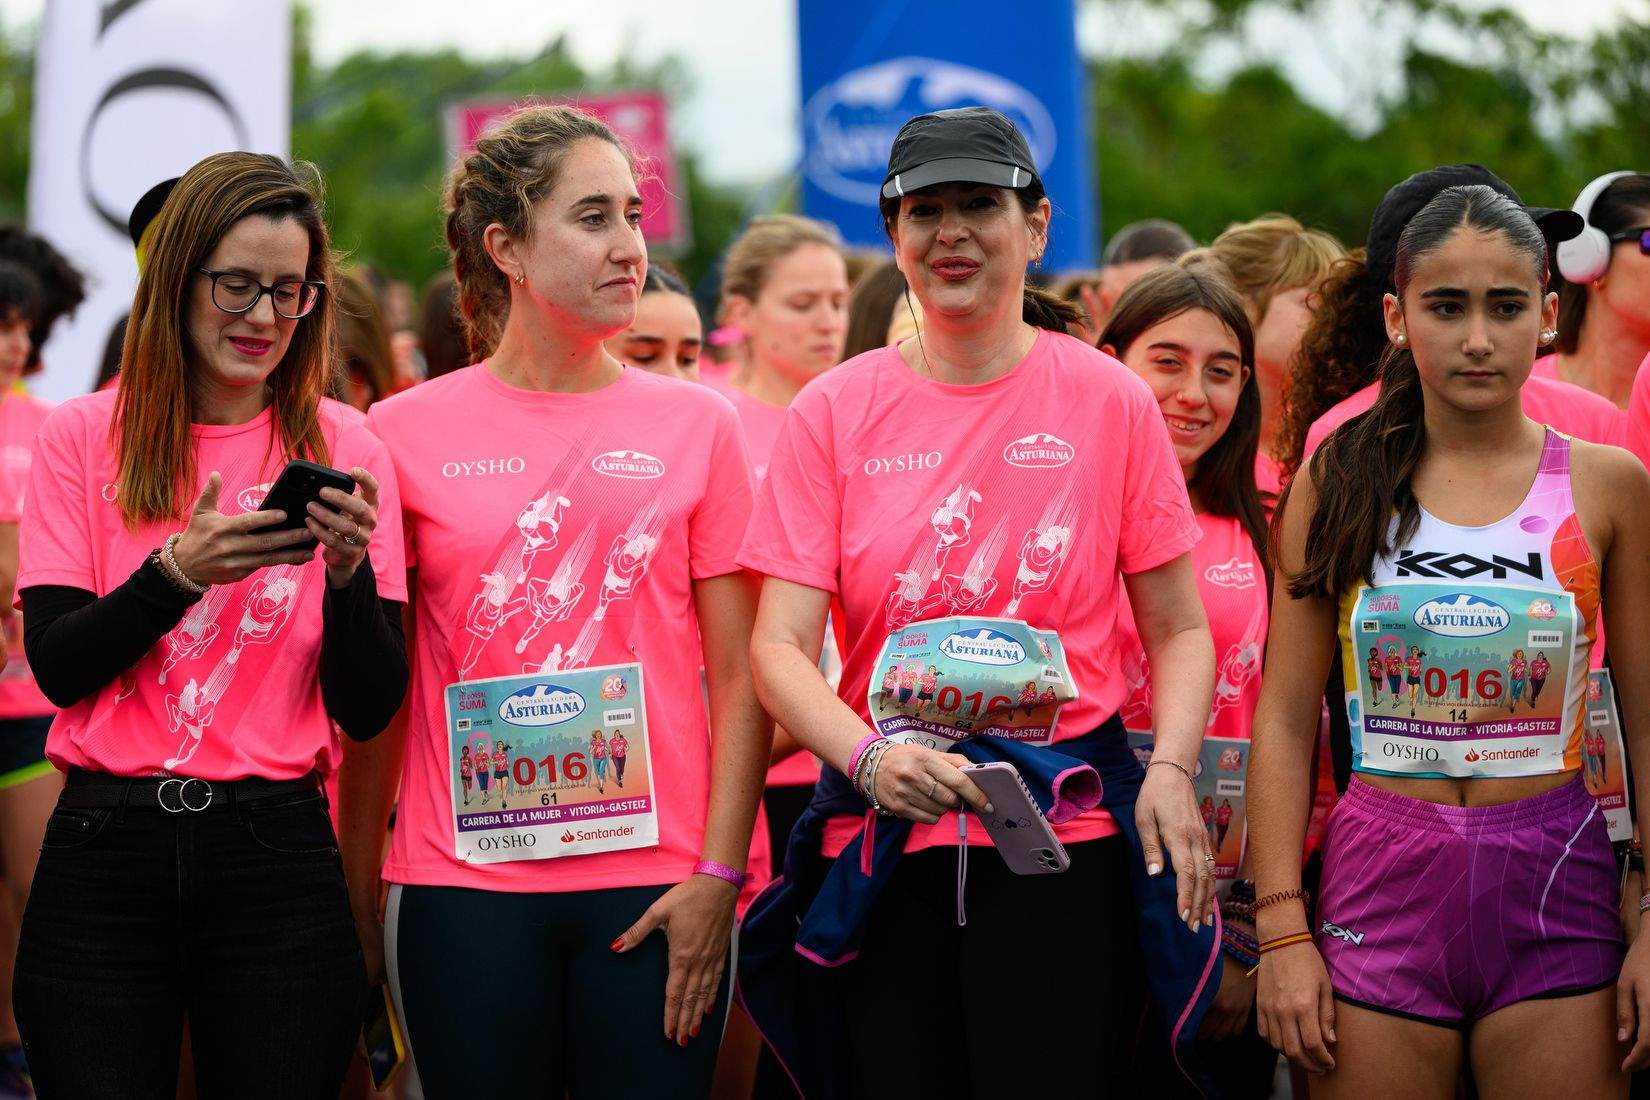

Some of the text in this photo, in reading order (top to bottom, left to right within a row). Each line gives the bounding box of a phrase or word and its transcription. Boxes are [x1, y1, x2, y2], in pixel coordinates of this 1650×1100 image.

[864, 451, 942, 475] OYSHO
[1009, 448, 1069, 462] ASTURIANA
[442, 457, 525, 477] OYSHO
[598, 459, 660, 474] ASTURIANA
[1395, 550, 1544, 581] KON
[1368, 601, 1400, 613] SUMA
[1420, 608, 1503, 627] ASTURIANA
[897, 638, 928, 649] SUMA
[943, 638, 1020, 661] ASTURIANA
[1423, 667, 1504, 700] 016
[459, 699, 487, 711] SUMA
[505, 701, 580, 719] ASTURIANA
[1449, 709, 1468, 723] 14
[911, 720, 923, 728] DE
[924, 724, 936, 732] LA
[1369, 719, 1556, 736] CARRERA DE LA MUJER VITORIA-GASTEIZ
[1383, 741, 1439, 762] OYSHO
[1481, 747, 1541, 761] Santander
[512, 751, 588, 786] 016
[540, 792, 558, 806] 61
[462, 799, 647, 827] CARRERA DE LA MUJER VITORIA-GASTEIZ
[478, 833, 537, 851] OYSHO
[576, 825, 635, 842] Santander
